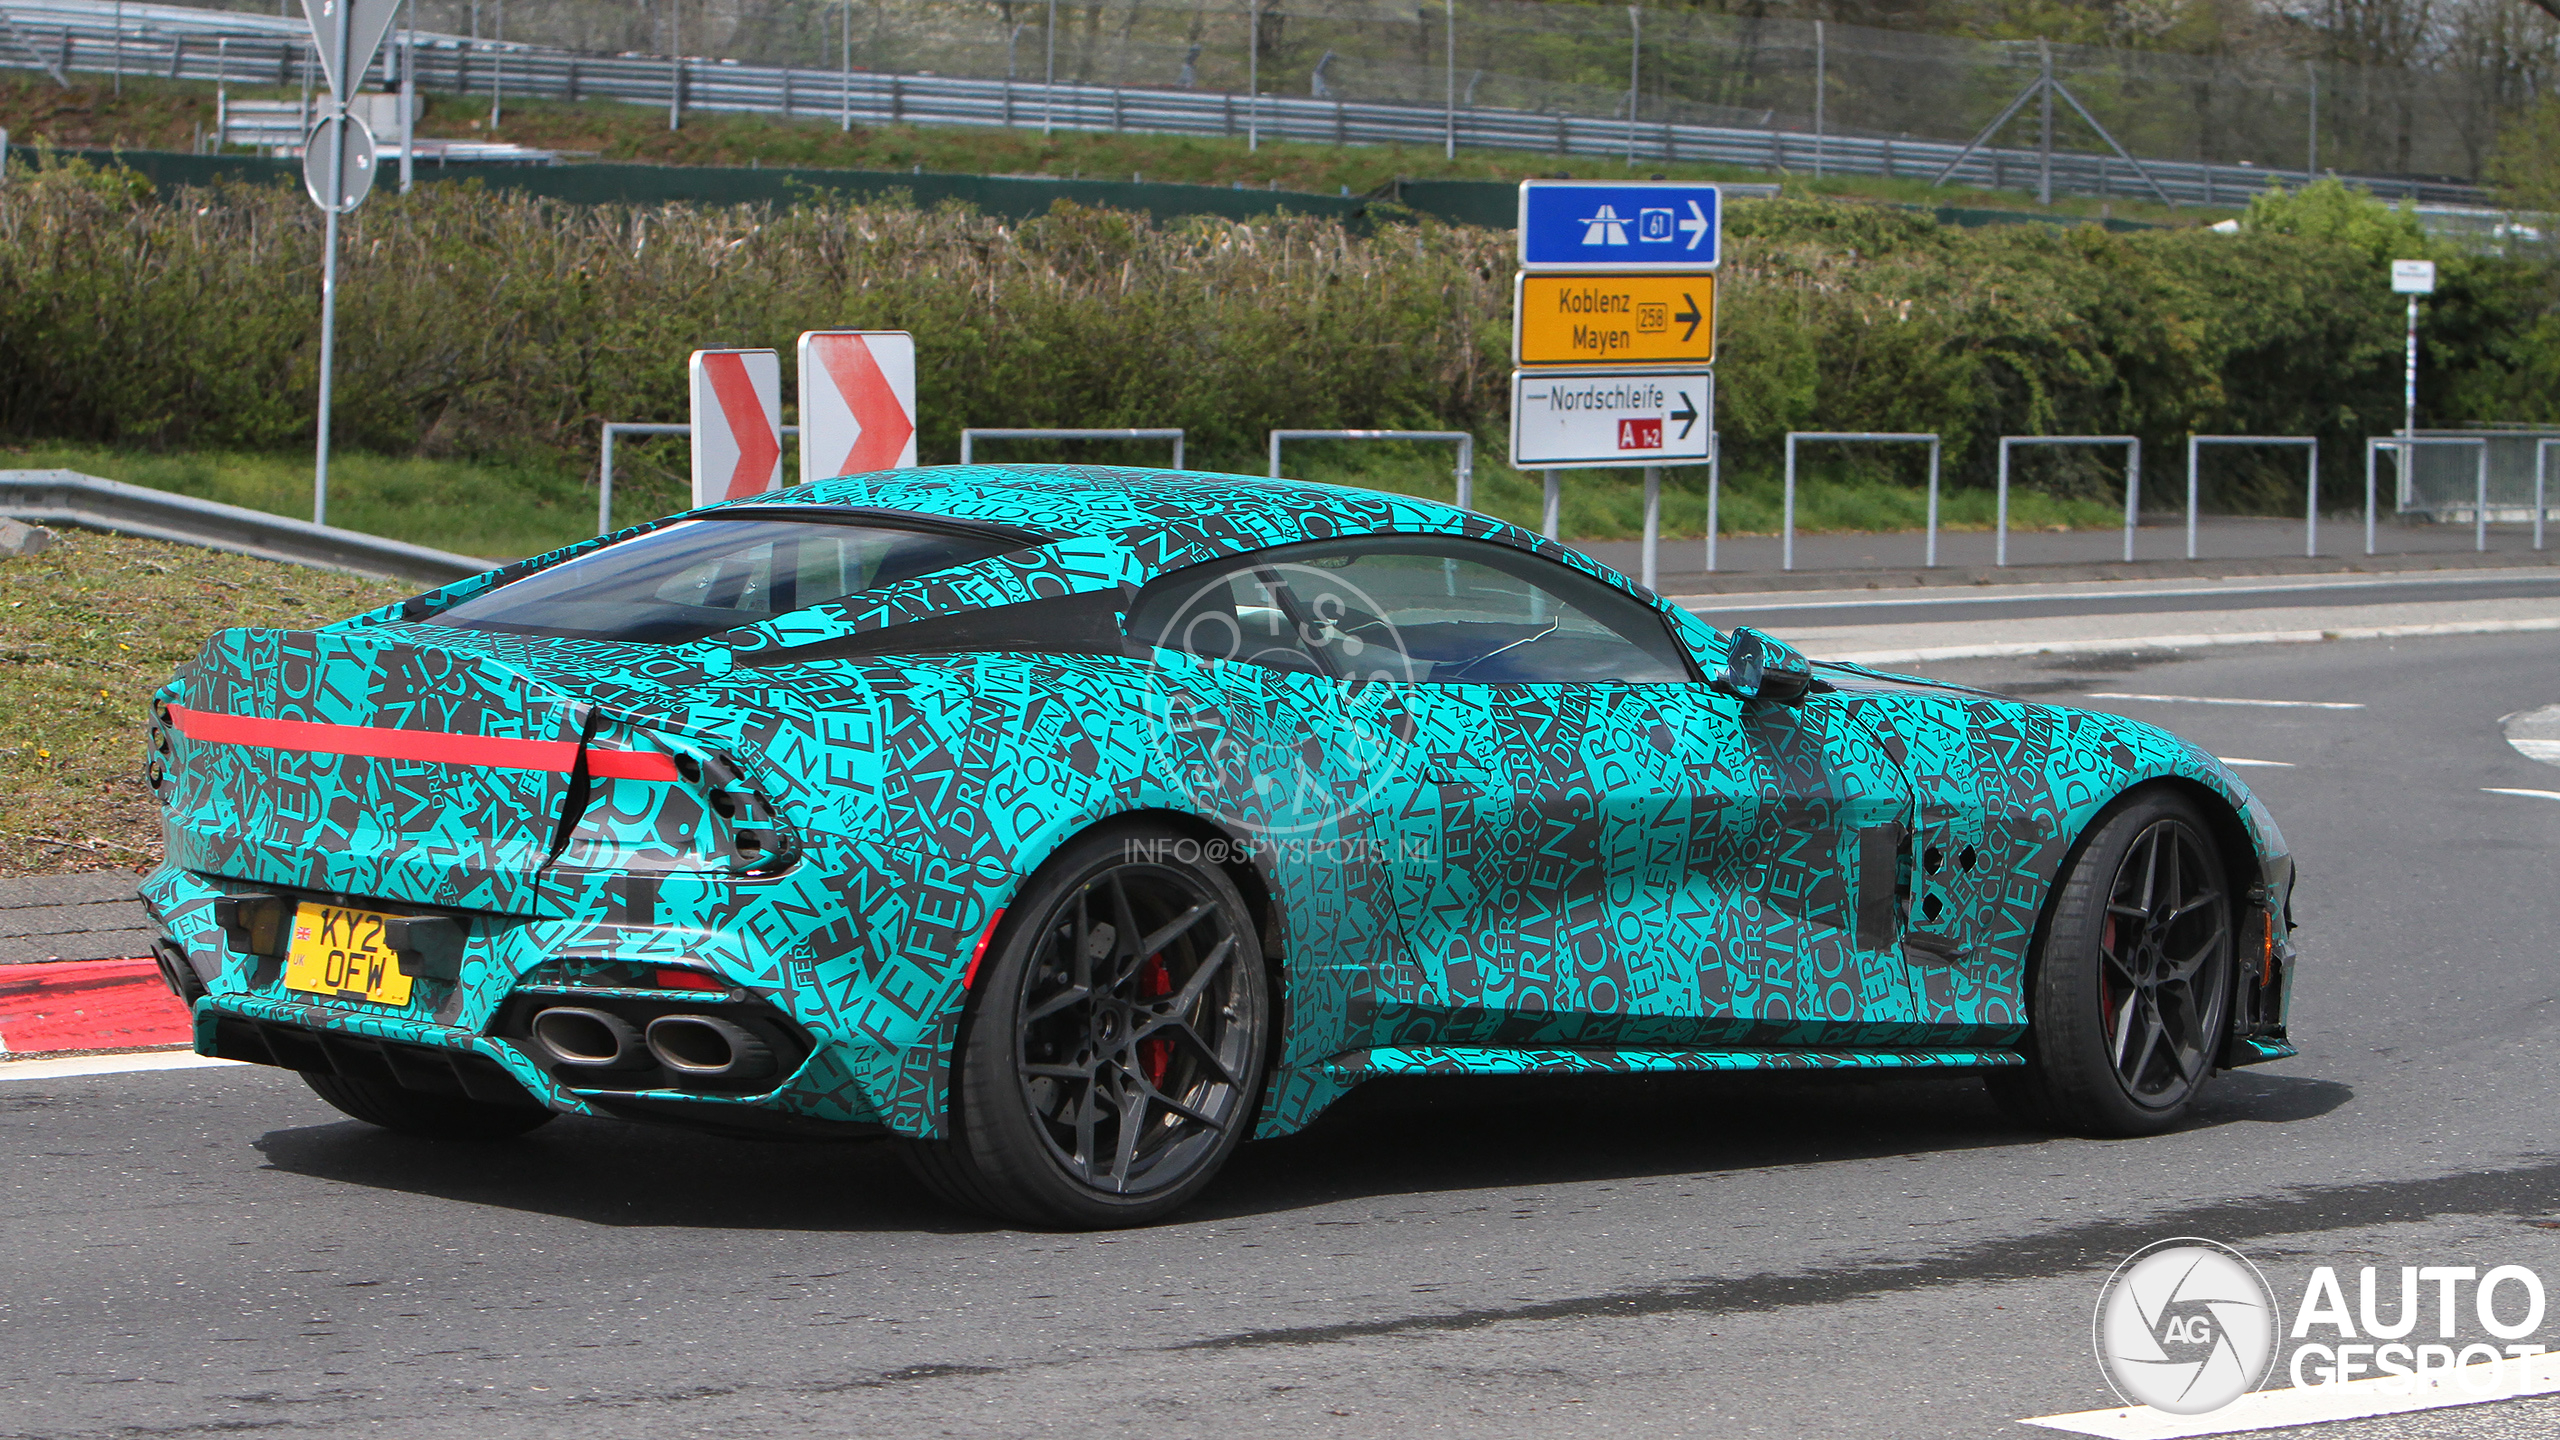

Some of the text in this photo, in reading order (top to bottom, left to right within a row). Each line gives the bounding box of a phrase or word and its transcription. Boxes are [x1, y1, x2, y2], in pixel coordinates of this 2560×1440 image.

[1649, 215, 1664, 235] 61
[1558, 288, 1630, 314] Koblenz
[1639, 307, 1664, 328] 258
[1572, 324, 1630, 355] Mayen
[1550, 384, 1664, 411] Nordschleife
[1620, 421, 1636, 448] A
[320, 908, 394, 955] KY2
[293, 954, 306, 966] UK
[324, 950, 387, 993] OFW
